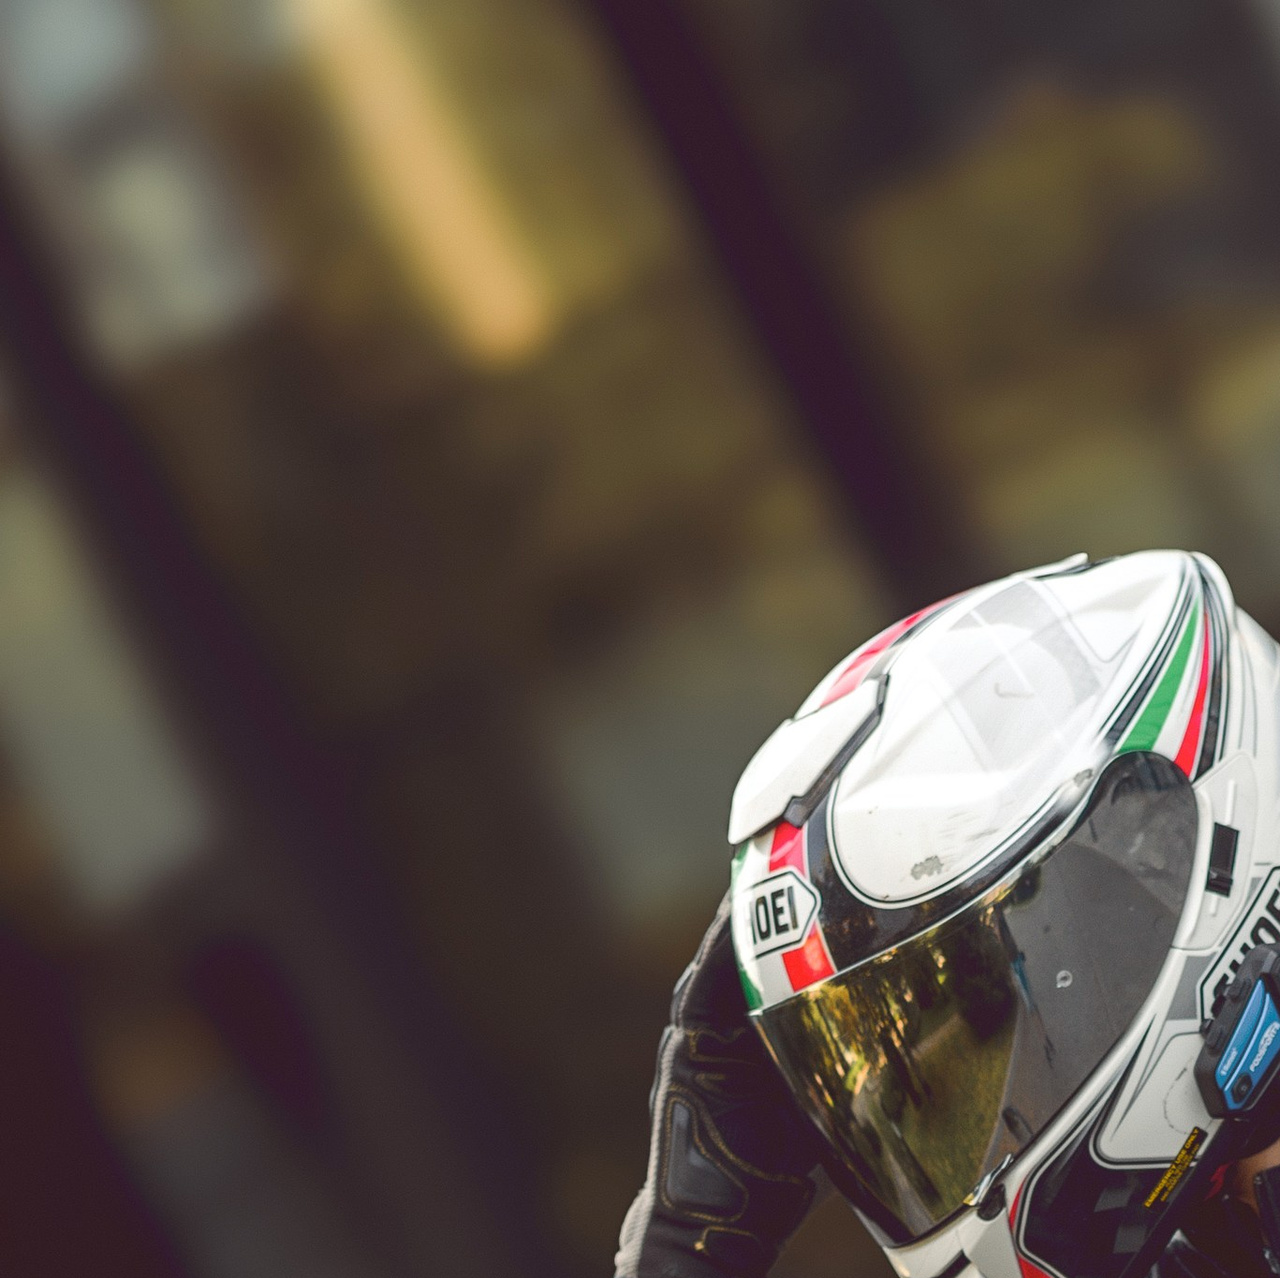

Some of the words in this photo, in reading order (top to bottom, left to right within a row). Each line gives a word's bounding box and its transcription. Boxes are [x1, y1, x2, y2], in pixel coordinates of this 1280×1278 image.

[1144, 1164, 1176, 1208] EMERGENCY
[1174, 1149, 1187, 1164] USE
[1184, 1128, 1199, 1149] ONLY
